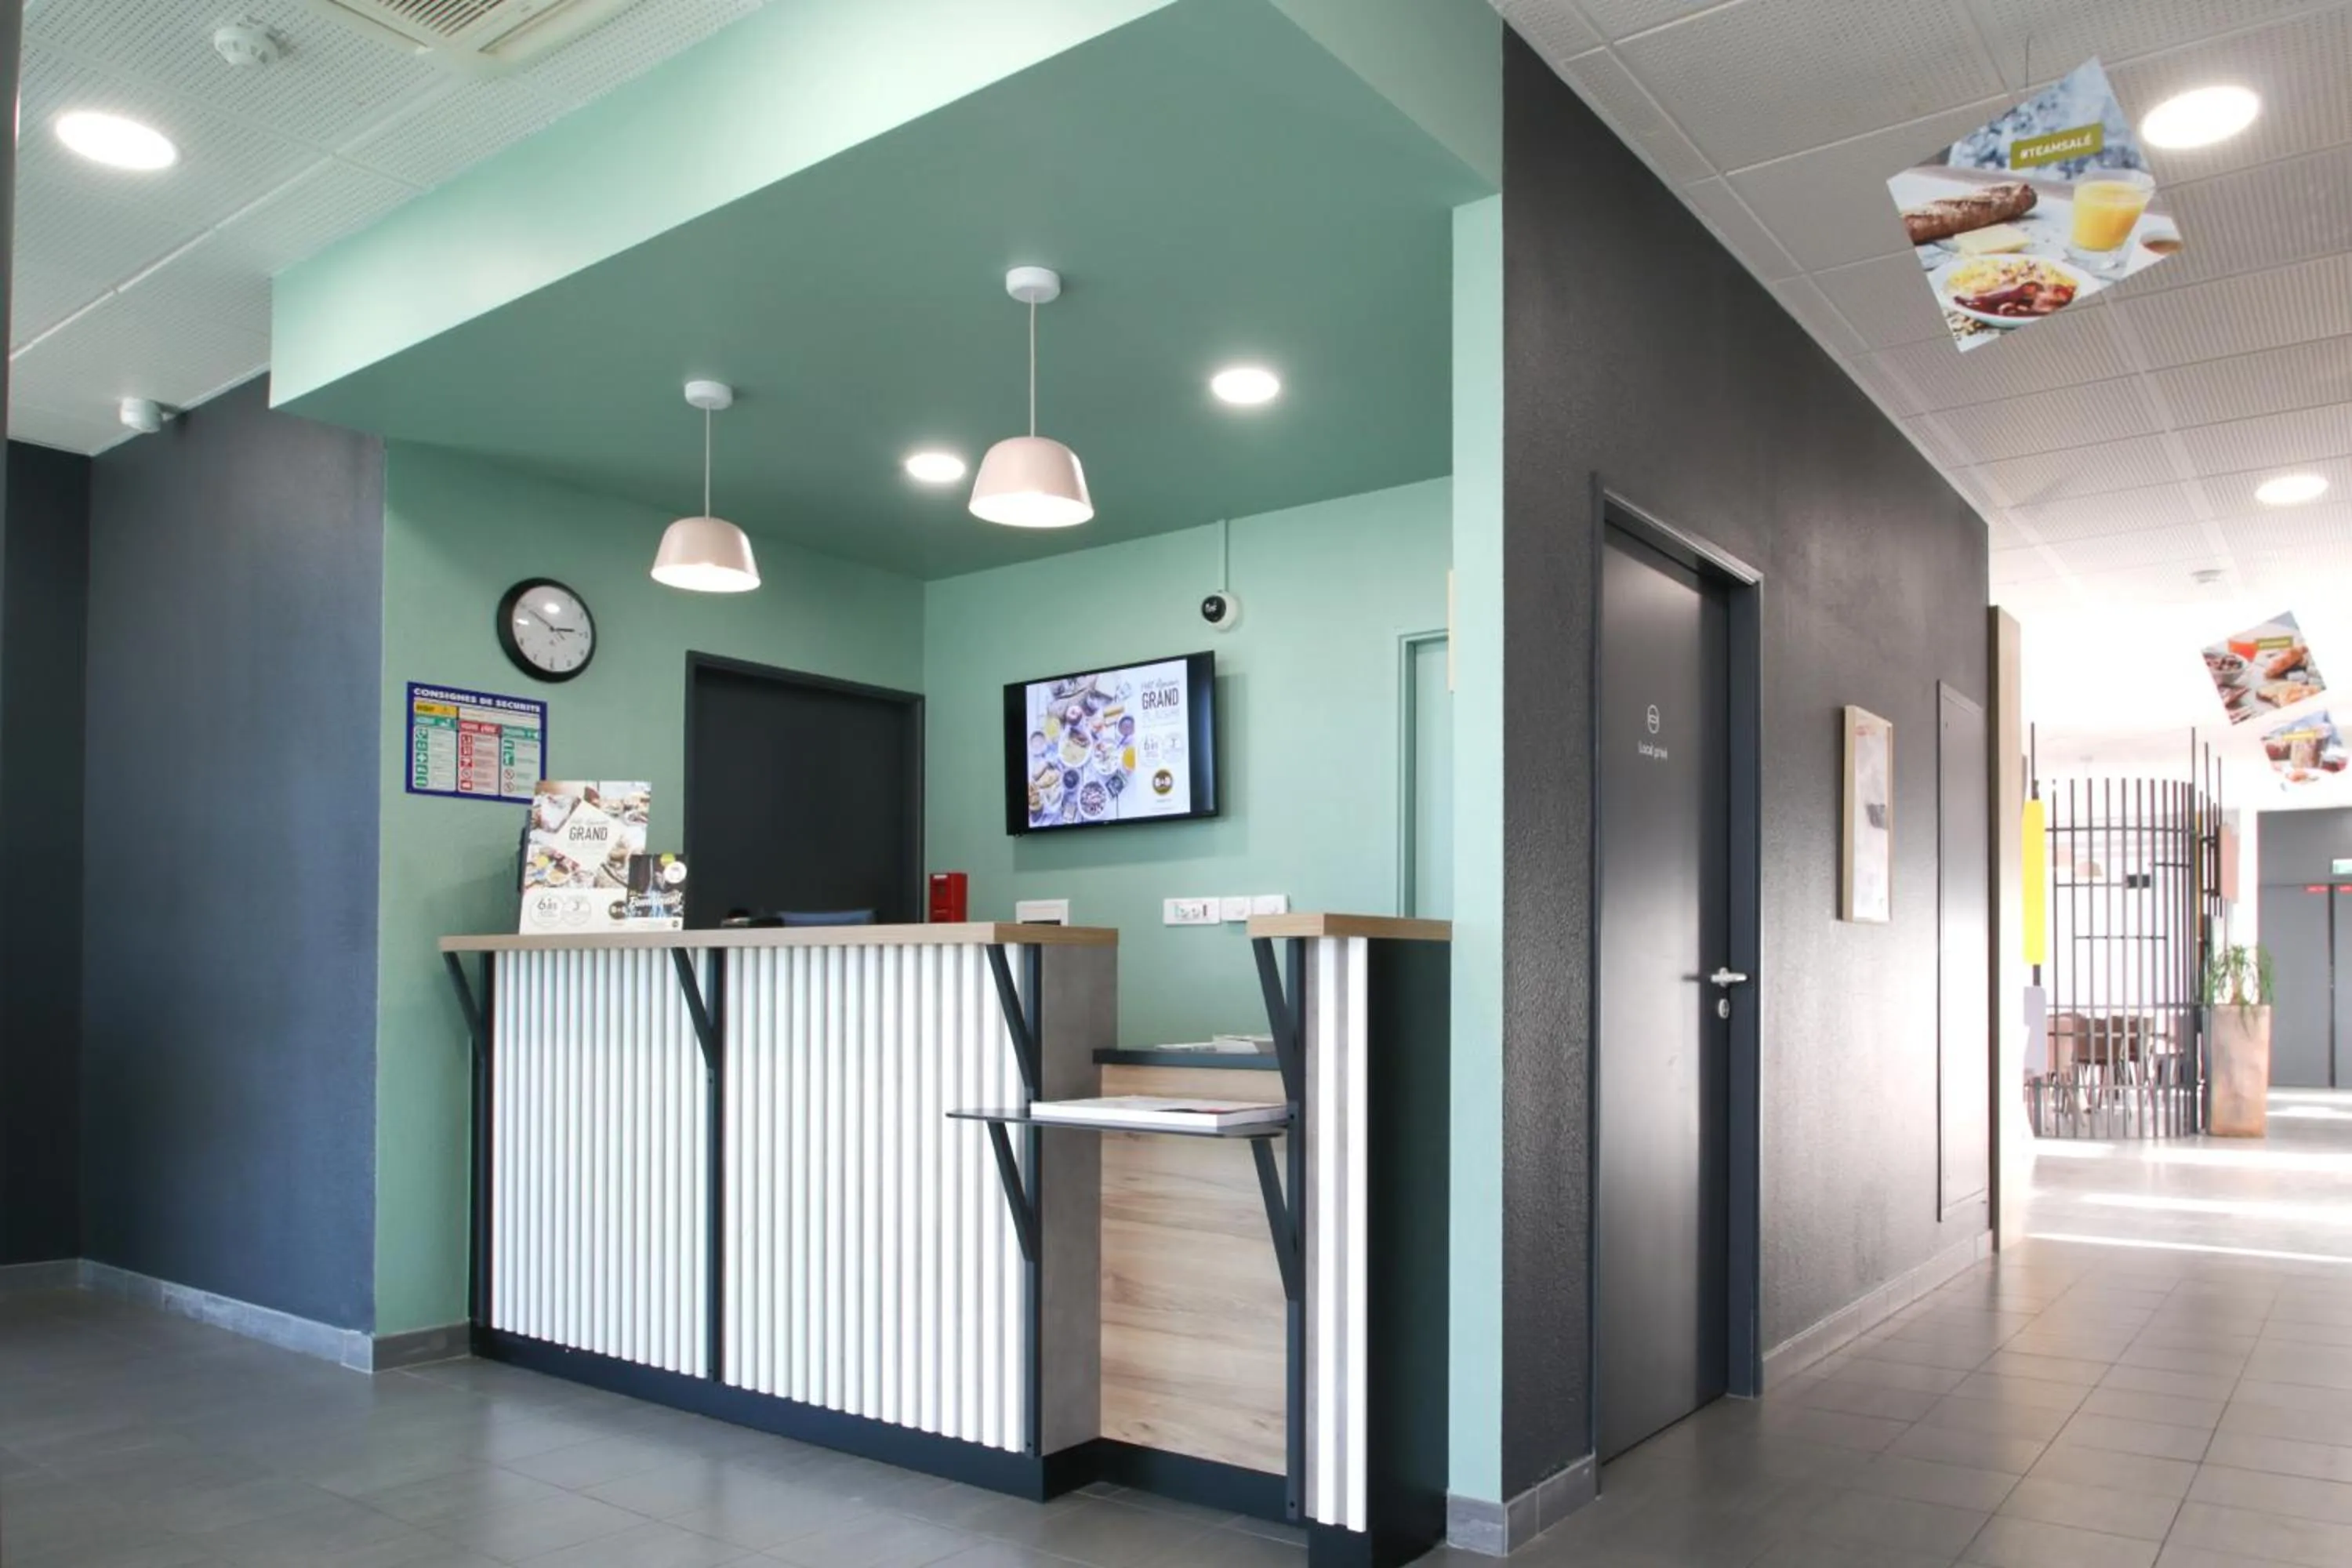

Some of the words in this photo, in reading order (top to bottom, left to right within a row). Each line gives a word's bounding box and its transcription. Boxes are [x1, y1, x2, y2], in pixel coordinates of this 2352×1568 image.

[2020, 131, 2092, 159] #TEAMSALÉ
[414, 688, 477, 704] CONSIGNES
[480, 697, 493, 706] DE
[1142, 688, 1179, 710] GRAND
[569, 826, 608, 841] GRAND
